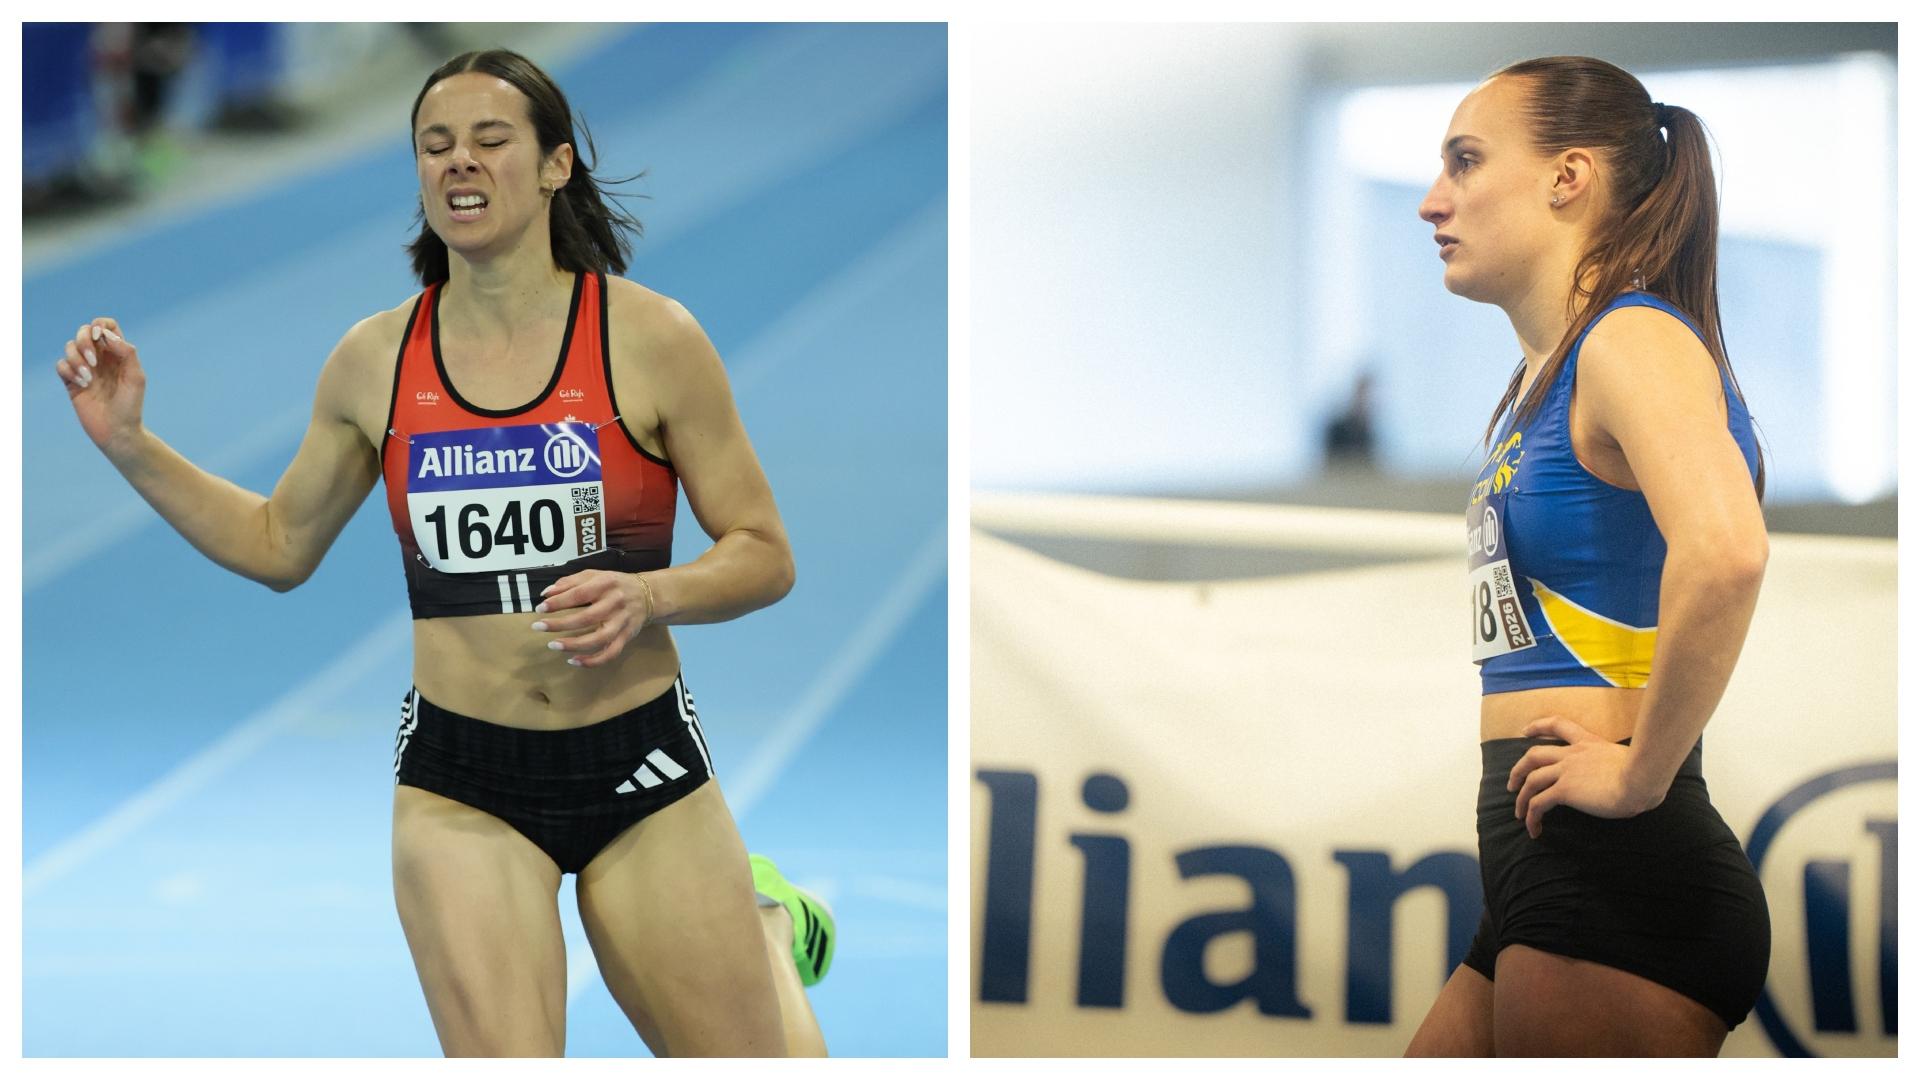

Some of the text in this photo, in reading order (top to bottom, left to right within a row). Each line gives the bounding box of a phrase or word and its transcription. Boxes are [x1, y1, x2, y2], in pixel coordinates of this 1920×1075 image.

[418, 446, 536, 479] Allianz
[425, 499, 566, 560] 1640
[581, 517, 597, 552] 2026
[1503, 602, 1526, 646] 2026
